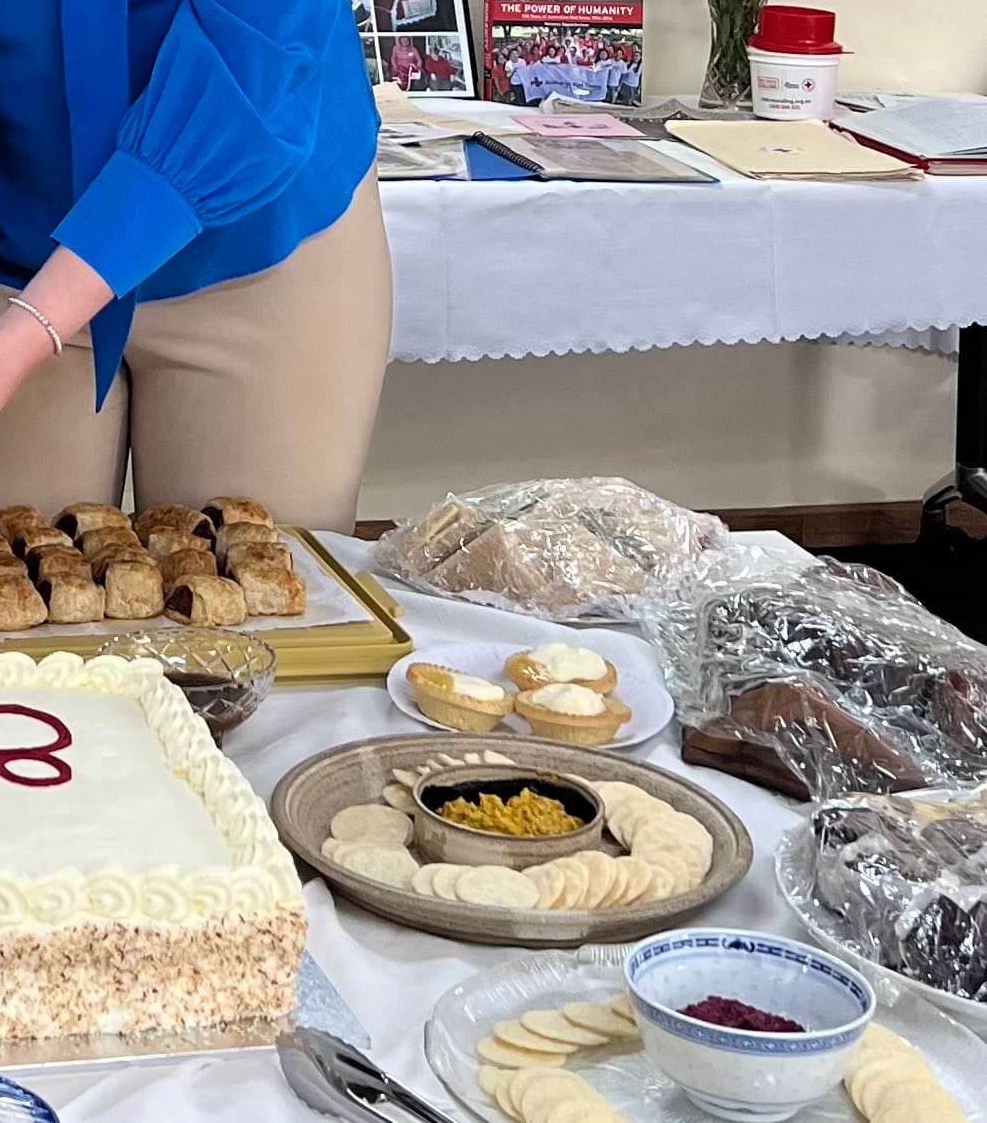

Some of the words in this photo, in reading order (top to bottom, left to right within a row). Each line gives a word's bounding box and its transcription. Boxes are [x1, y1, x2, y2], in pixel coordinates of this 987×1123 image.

[501, 3, 521, 13] THE
[524, 3, 560, 14] POWER
[563, 4, 576, 15] OF
[578, 5, 634, 16] HUMANITY
